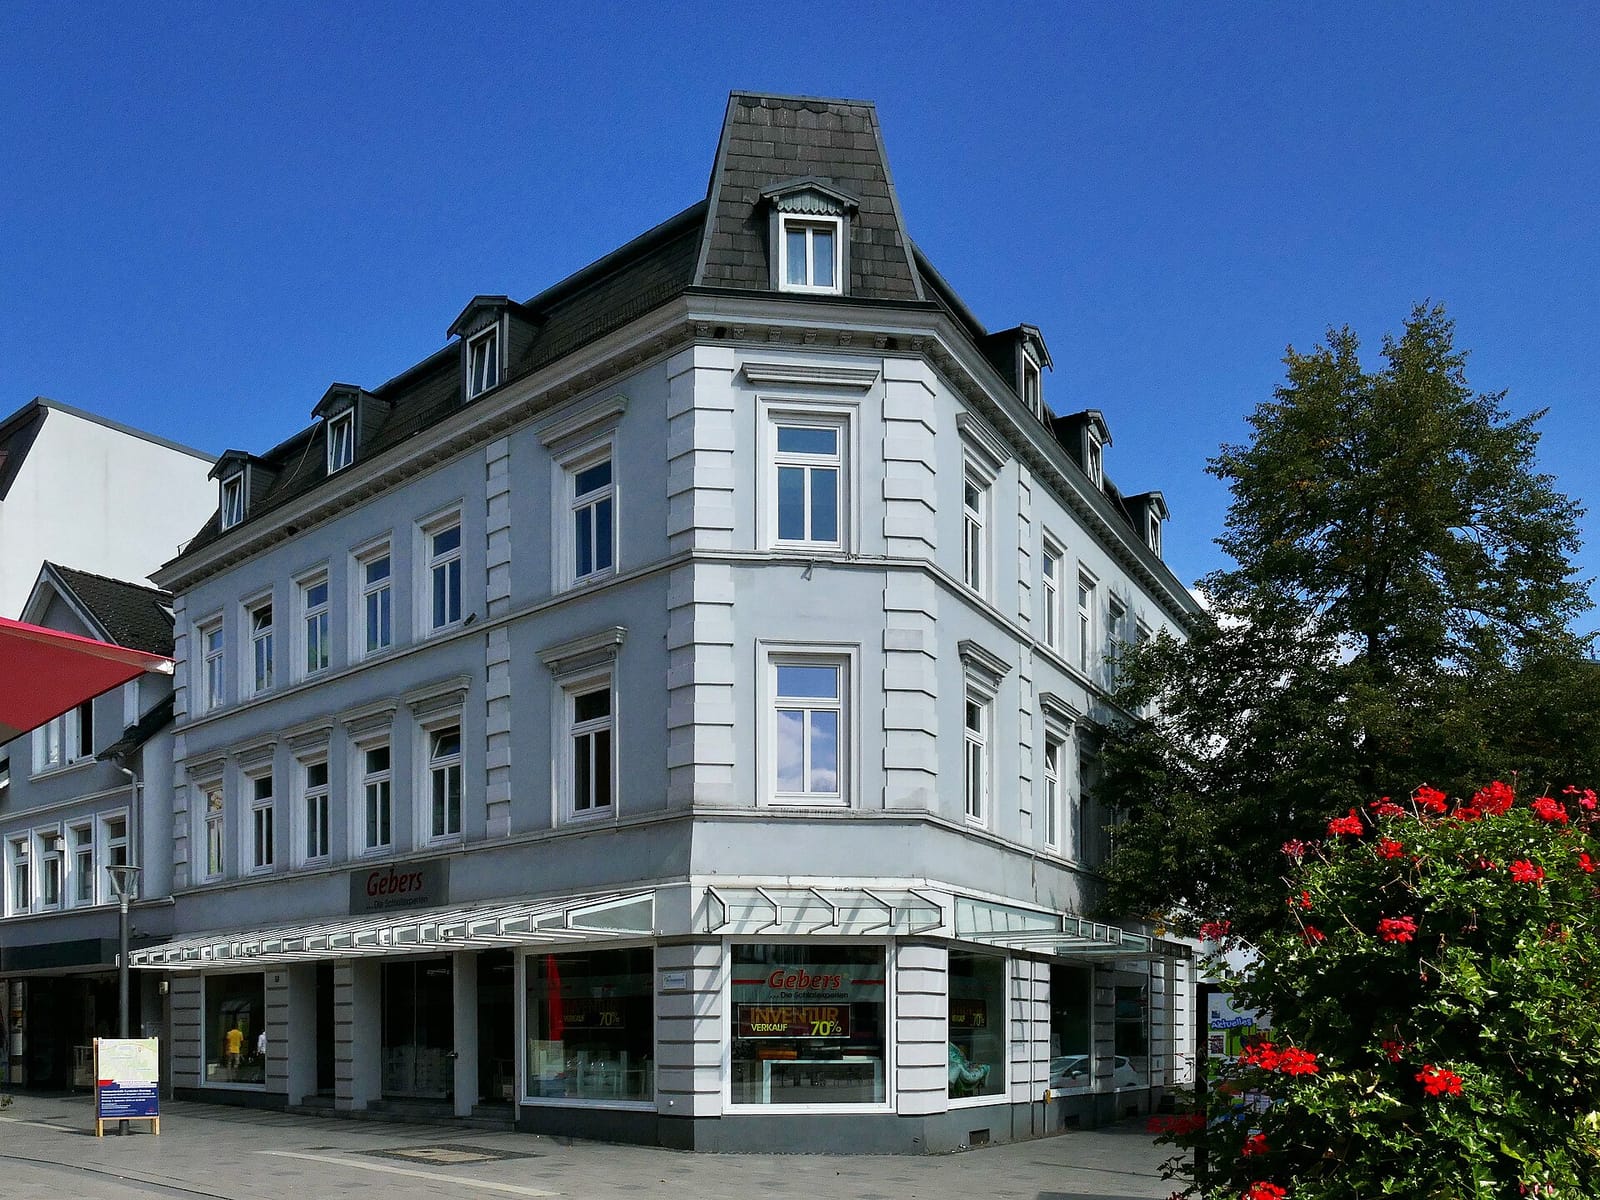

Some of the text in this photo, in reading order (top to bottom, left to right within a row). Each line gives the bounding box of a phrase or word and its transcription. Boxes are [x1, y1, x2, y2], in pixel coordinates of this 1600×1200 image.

[367, 868, 423, 896] Gebers
[769, 969, 841, 989] Gebers
[750, 1007, 839, 1024] INVENTUR
[1211, 1017, 1254, 1030] Aktuelles
[751, 1021, 842, 1035] VERKAUF 70%
